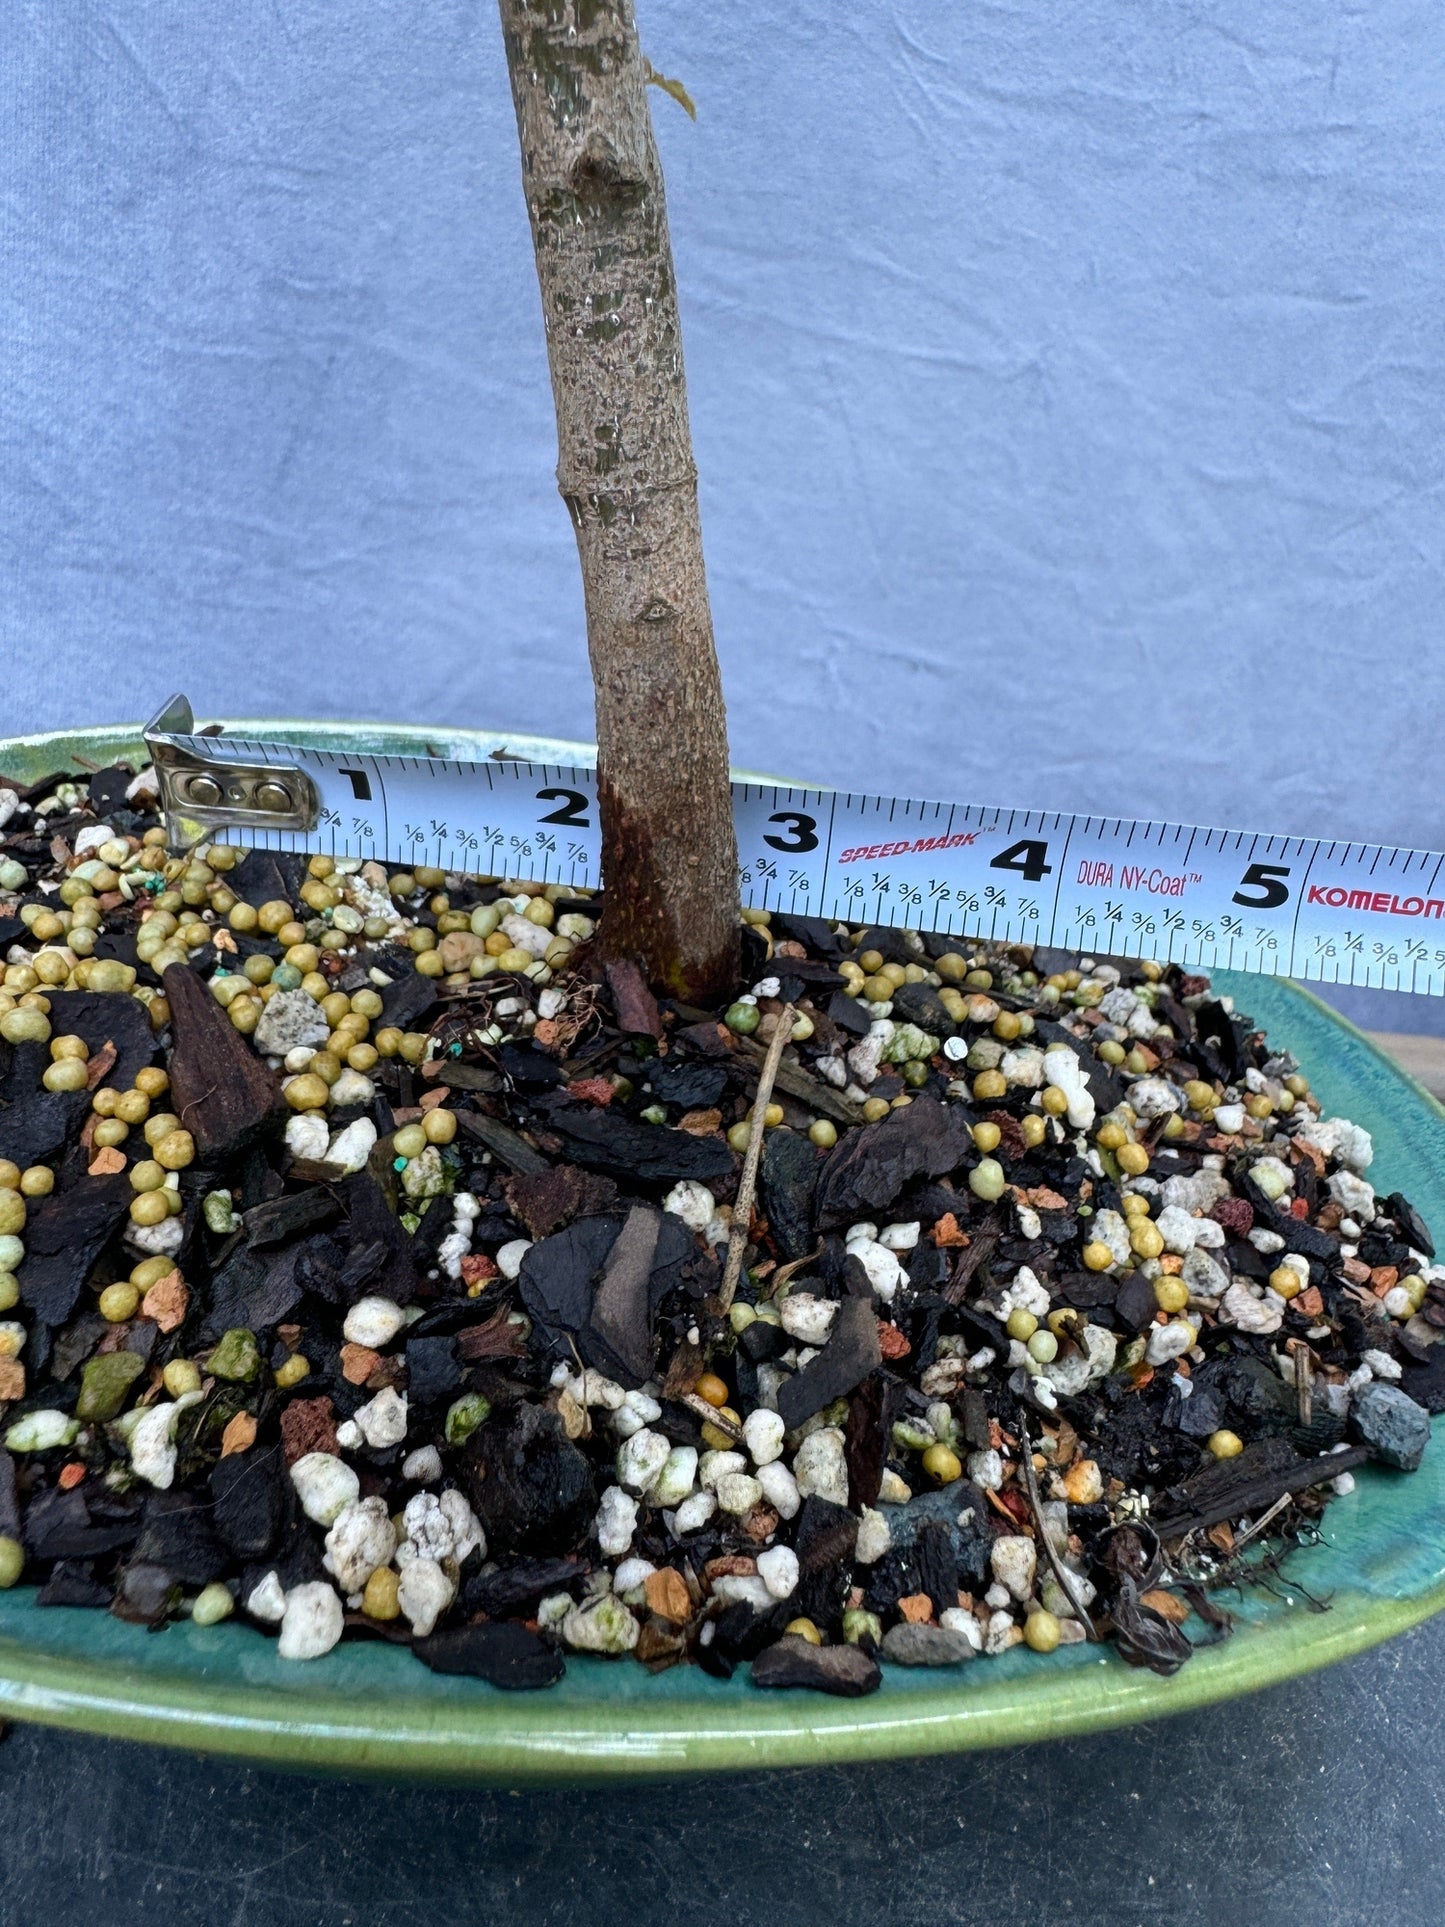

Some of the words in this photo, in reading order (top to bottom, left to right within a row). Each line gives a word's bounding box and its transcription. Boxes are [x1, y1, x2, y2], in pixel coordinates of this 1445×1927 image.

[338, 768, 372, 801] 1
[535, 788, 590, 828] 2
[763, 812, 819, 853] 3
[989, 839, 1053, 882] 4
[1077, 860, 1114, 888] DURA
[1231, 863, 1291, 909] 5
